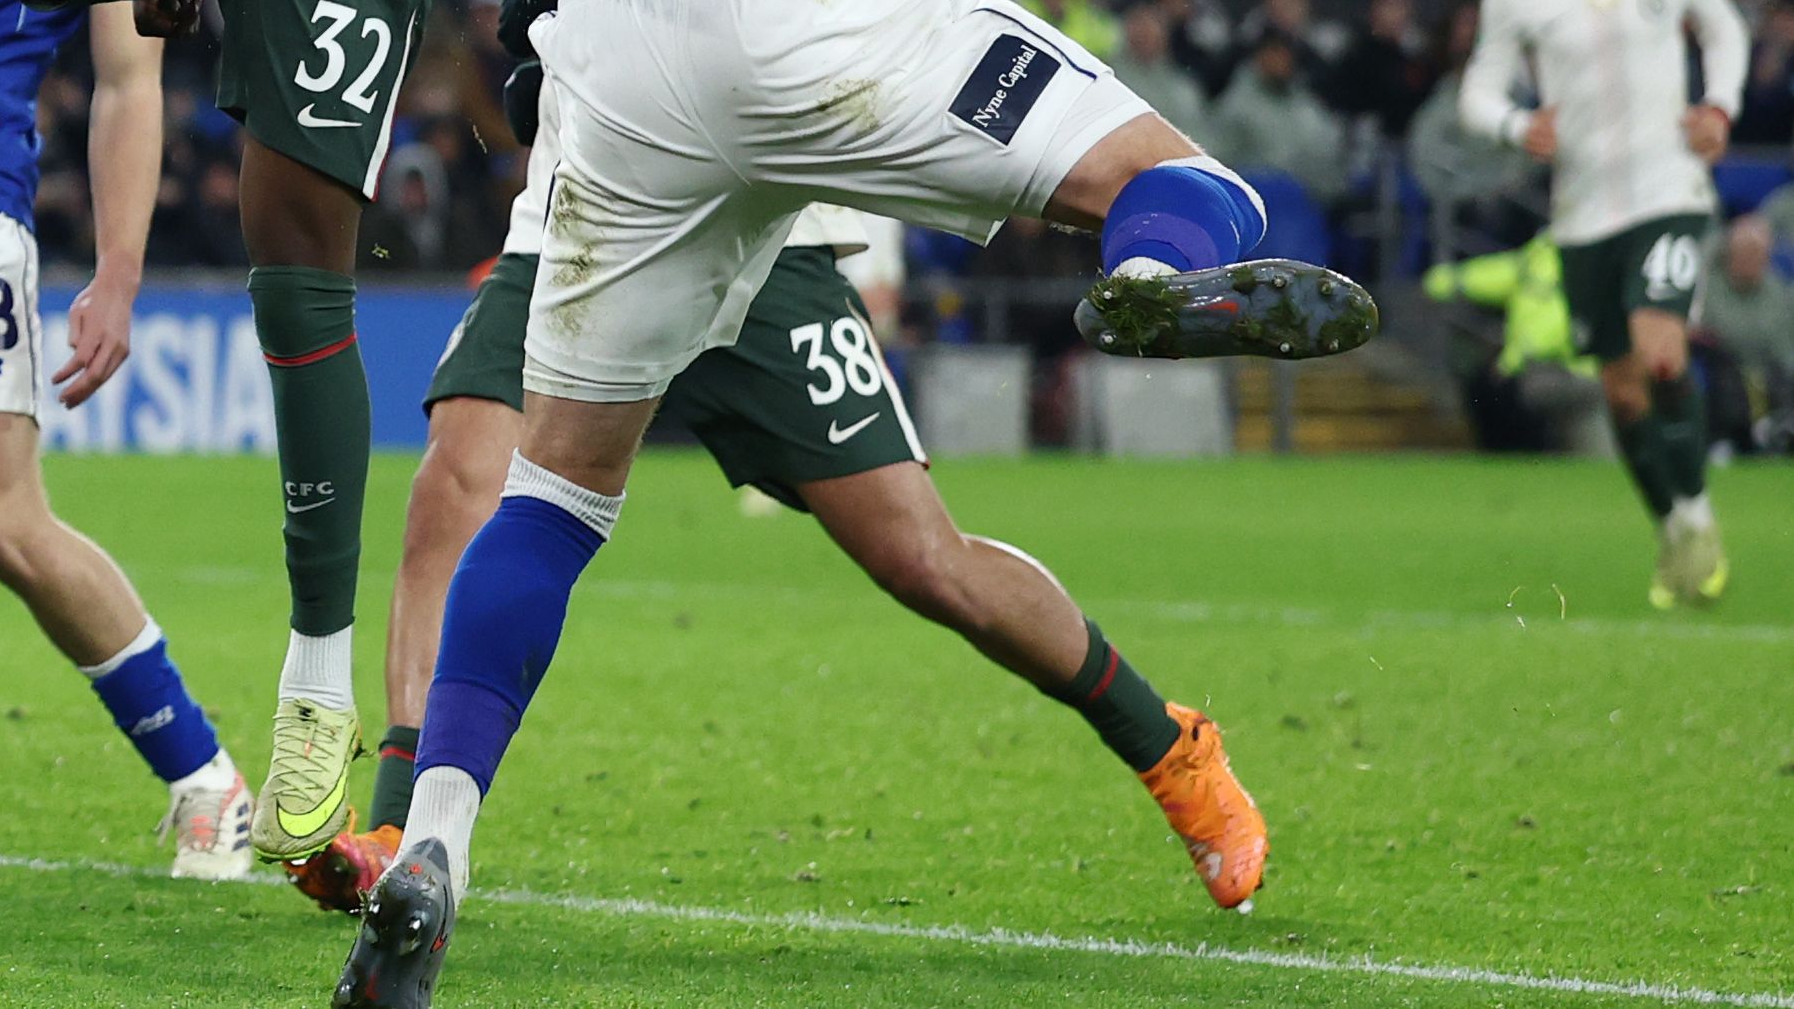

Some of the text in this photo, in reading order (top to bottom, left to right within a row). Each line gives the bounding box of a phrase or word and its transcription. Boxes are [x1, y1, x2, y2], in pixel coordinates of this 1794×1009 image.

[294, 0, 392, 114] 32
[972, 44, 1037, 128] Nyne Capital
[1641, 232, 1697, 290] 40
[789, 317, 882, 405] 38
[285, 480, 335, 497] CFC
